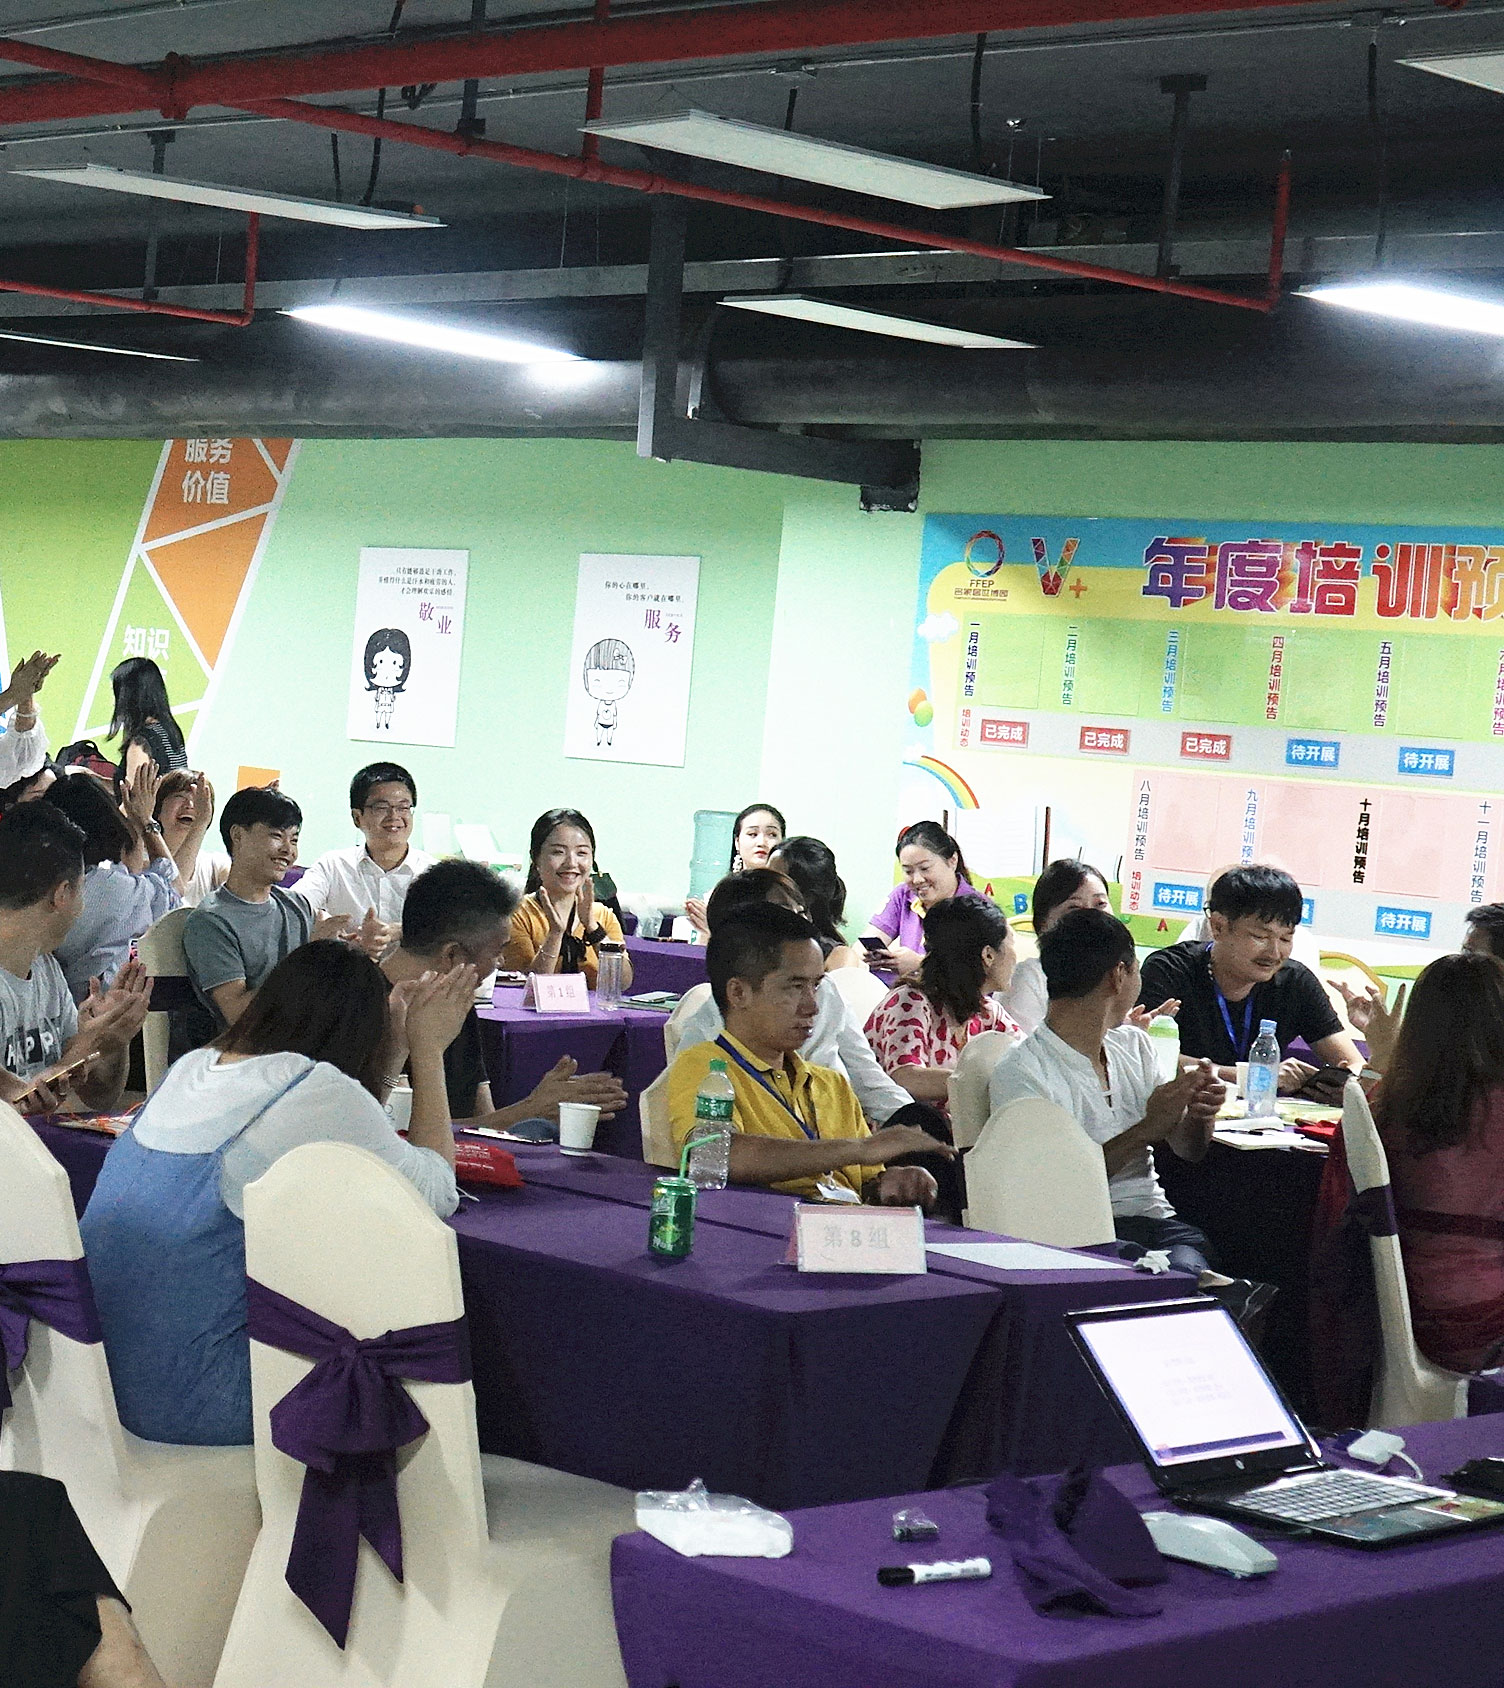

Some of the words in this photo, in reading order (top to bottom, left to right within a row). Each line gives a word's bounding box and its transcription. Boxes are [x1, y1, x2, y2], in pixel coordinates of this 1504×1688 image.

[184, 438, 234, 464] 服务
[181, 470, 231, 504] 价值
[970, 579, 995, 588] FFEP
[1142, 536, 1504, 623] 年度培训预
[419, 601, 452, 634] 敬业
[643, 609, 682, 643] 服务
[122, 624, 170, 661] 知识
[964, 623, 980, 697] 一月培训预告
[1062, 626, 1078, 706] 二月培训预告
[1162, 630, 1180, 713] 三月培训预告
[1265, 636, 1285, 720] 四月培训预告
[1373, 641, 1393, 728] 五月培训预告
[985, 724, 1024, 742] 已完成
[1084, 731, 1125, 749] 已完成
[1184, 735, 1228, 757] 已完成
[1291, 744, 1336, 763] 待开展
[1403, 752, 1450, 771] 待开展
[1134, 780, 1151, 861] 八月培训预告
[1352, 798, 1372, 884] 十月培训预告
[1471, 801, 1492, 904] 十一月培训预告
[1157, 887, 1200, 907] 待开展
[1380, 911, 1427, 933] 待开展
[823, 1224, 891, 1249] 第8组
